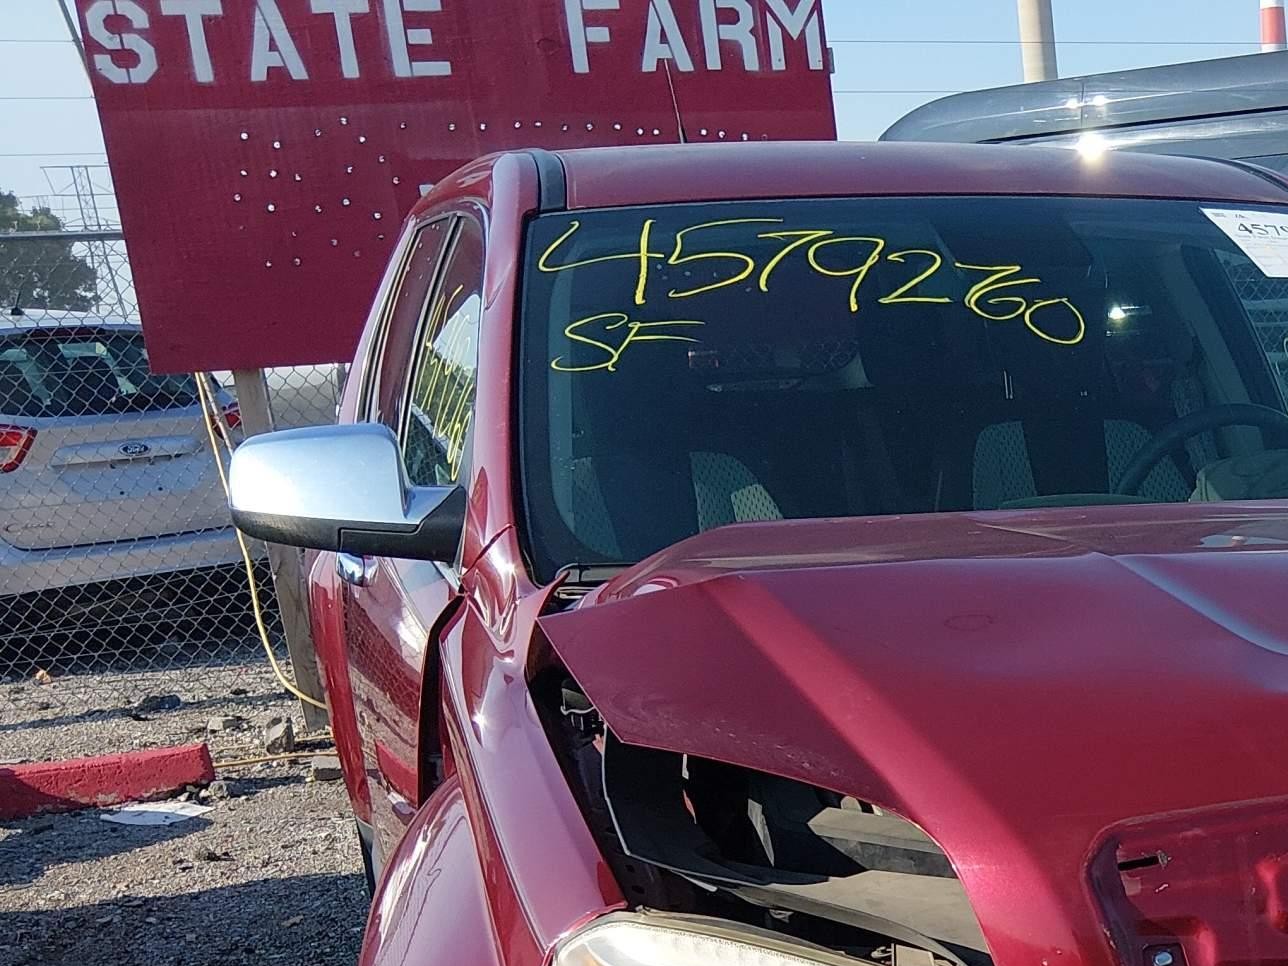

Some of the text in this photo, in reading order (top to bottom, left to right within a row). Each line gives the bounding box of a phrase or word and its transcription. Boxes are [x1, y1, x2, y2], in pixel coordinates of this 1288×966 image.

[85, 0, 824, 84] STATE FARM
[538, 218, 1086, 345] 45792760
[551, 313, 706, 373] SF
